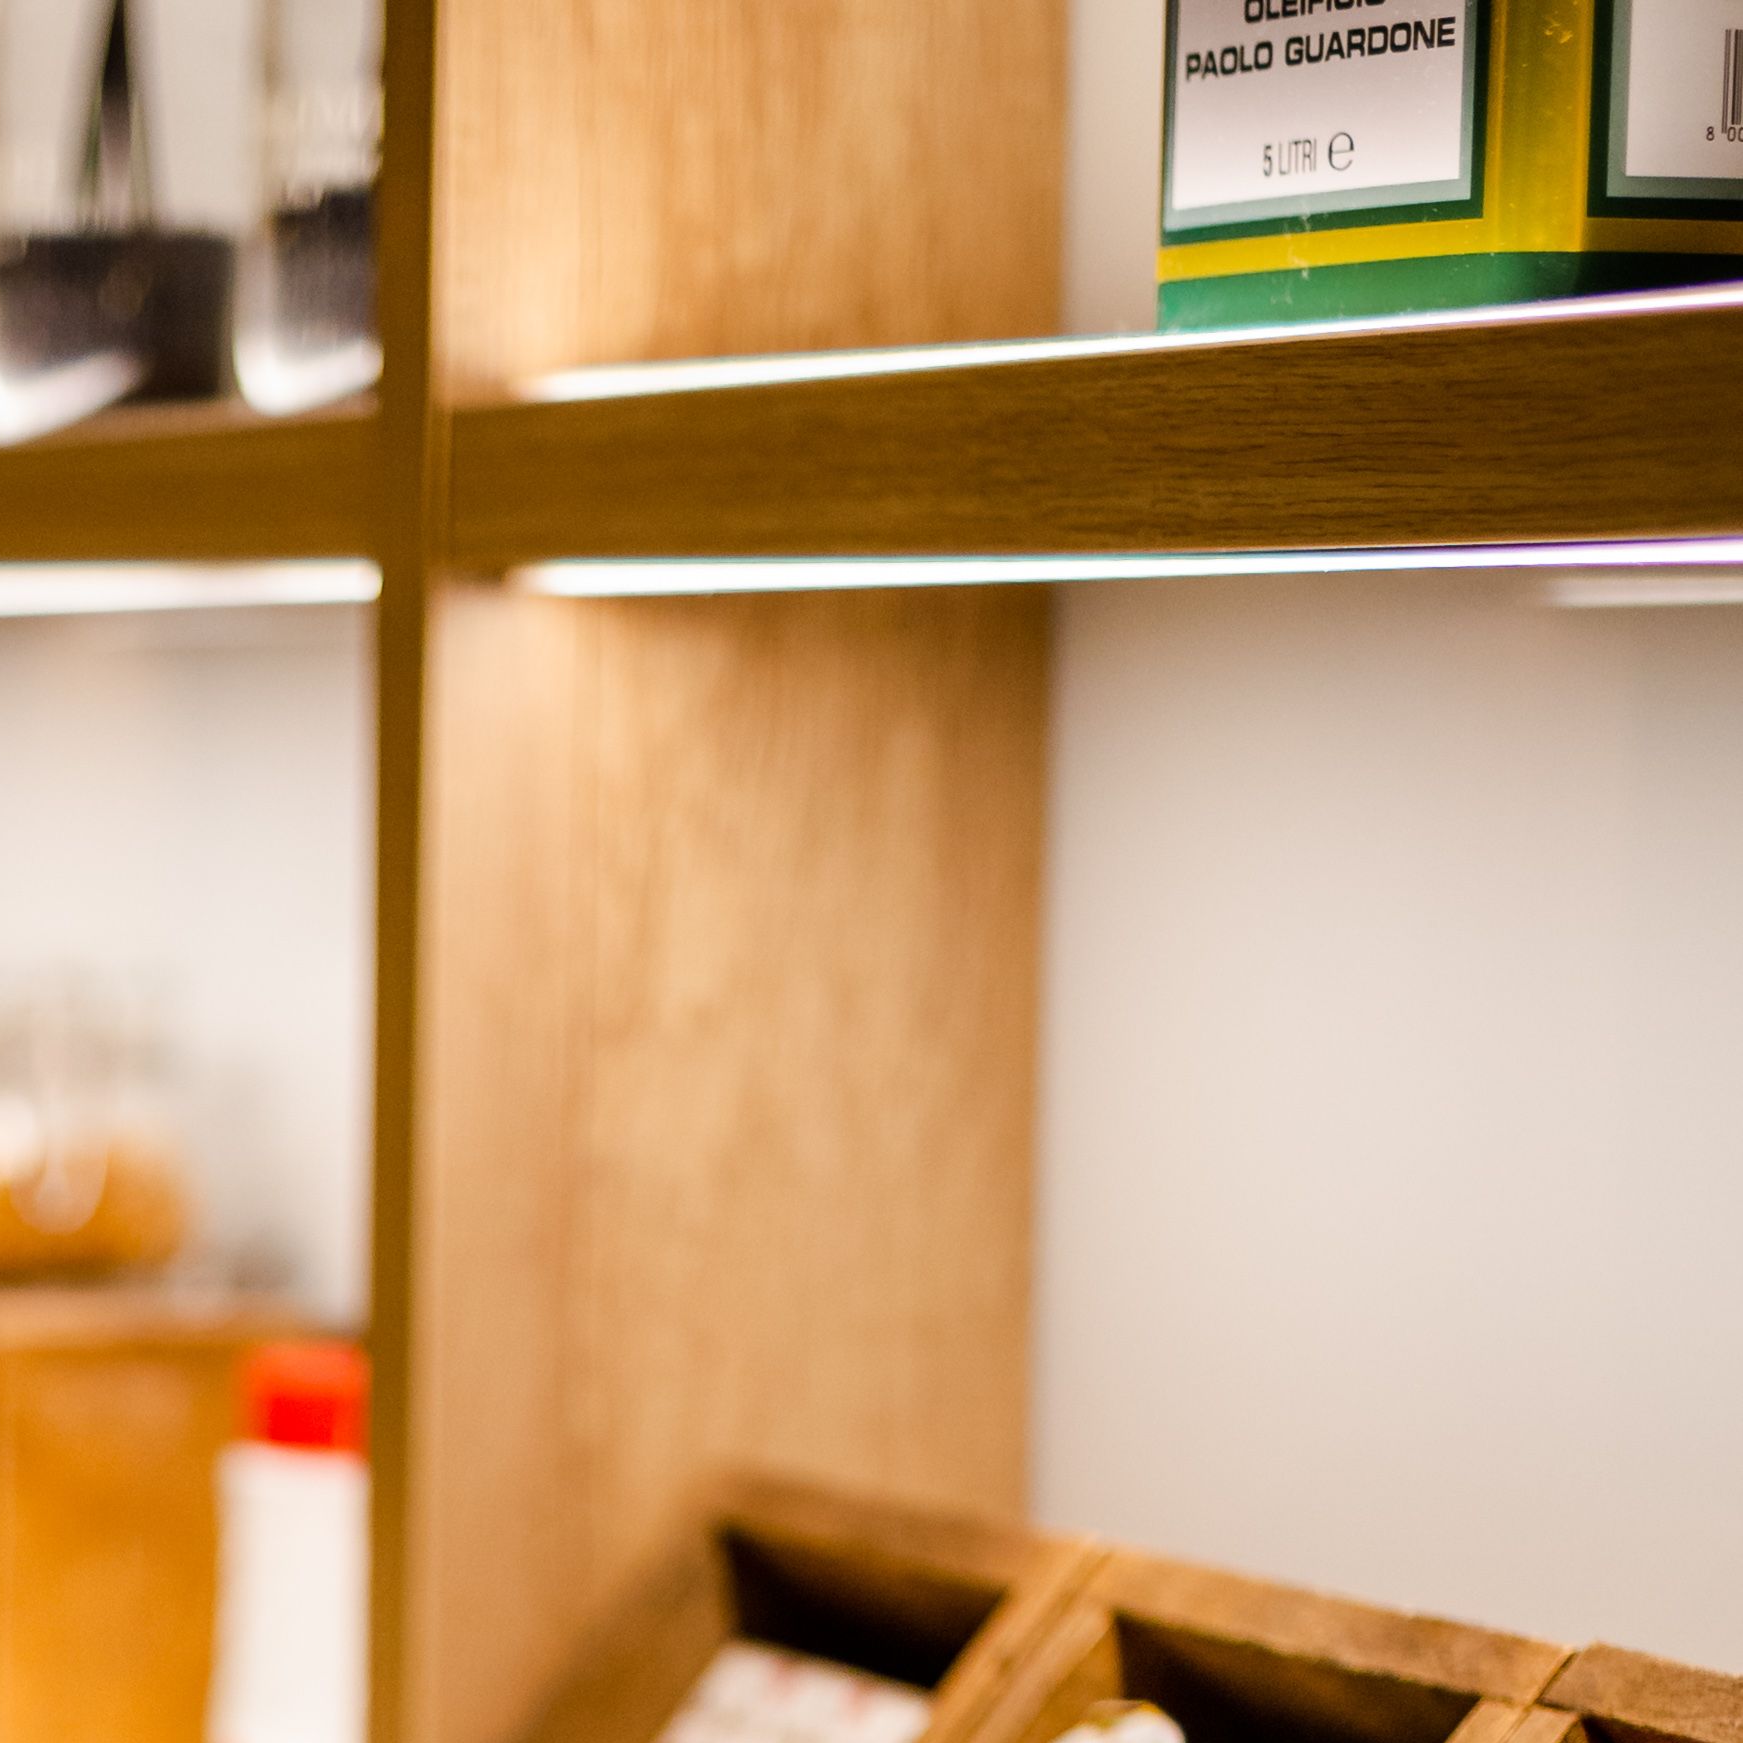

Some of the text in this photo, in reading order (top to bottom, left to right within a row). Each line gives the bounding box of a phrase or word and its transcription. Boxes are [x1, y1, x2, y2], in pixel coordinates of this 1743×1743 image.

[1244, 0, 1386, 23] OLEIF
[1186, 16, 1456, 82] PAOLO GUARDONE
[1706, 126, 1715, 141] 8
[1263, 144, 1272, 177] 5
[1278, 138, 1317, 175] LITRI
